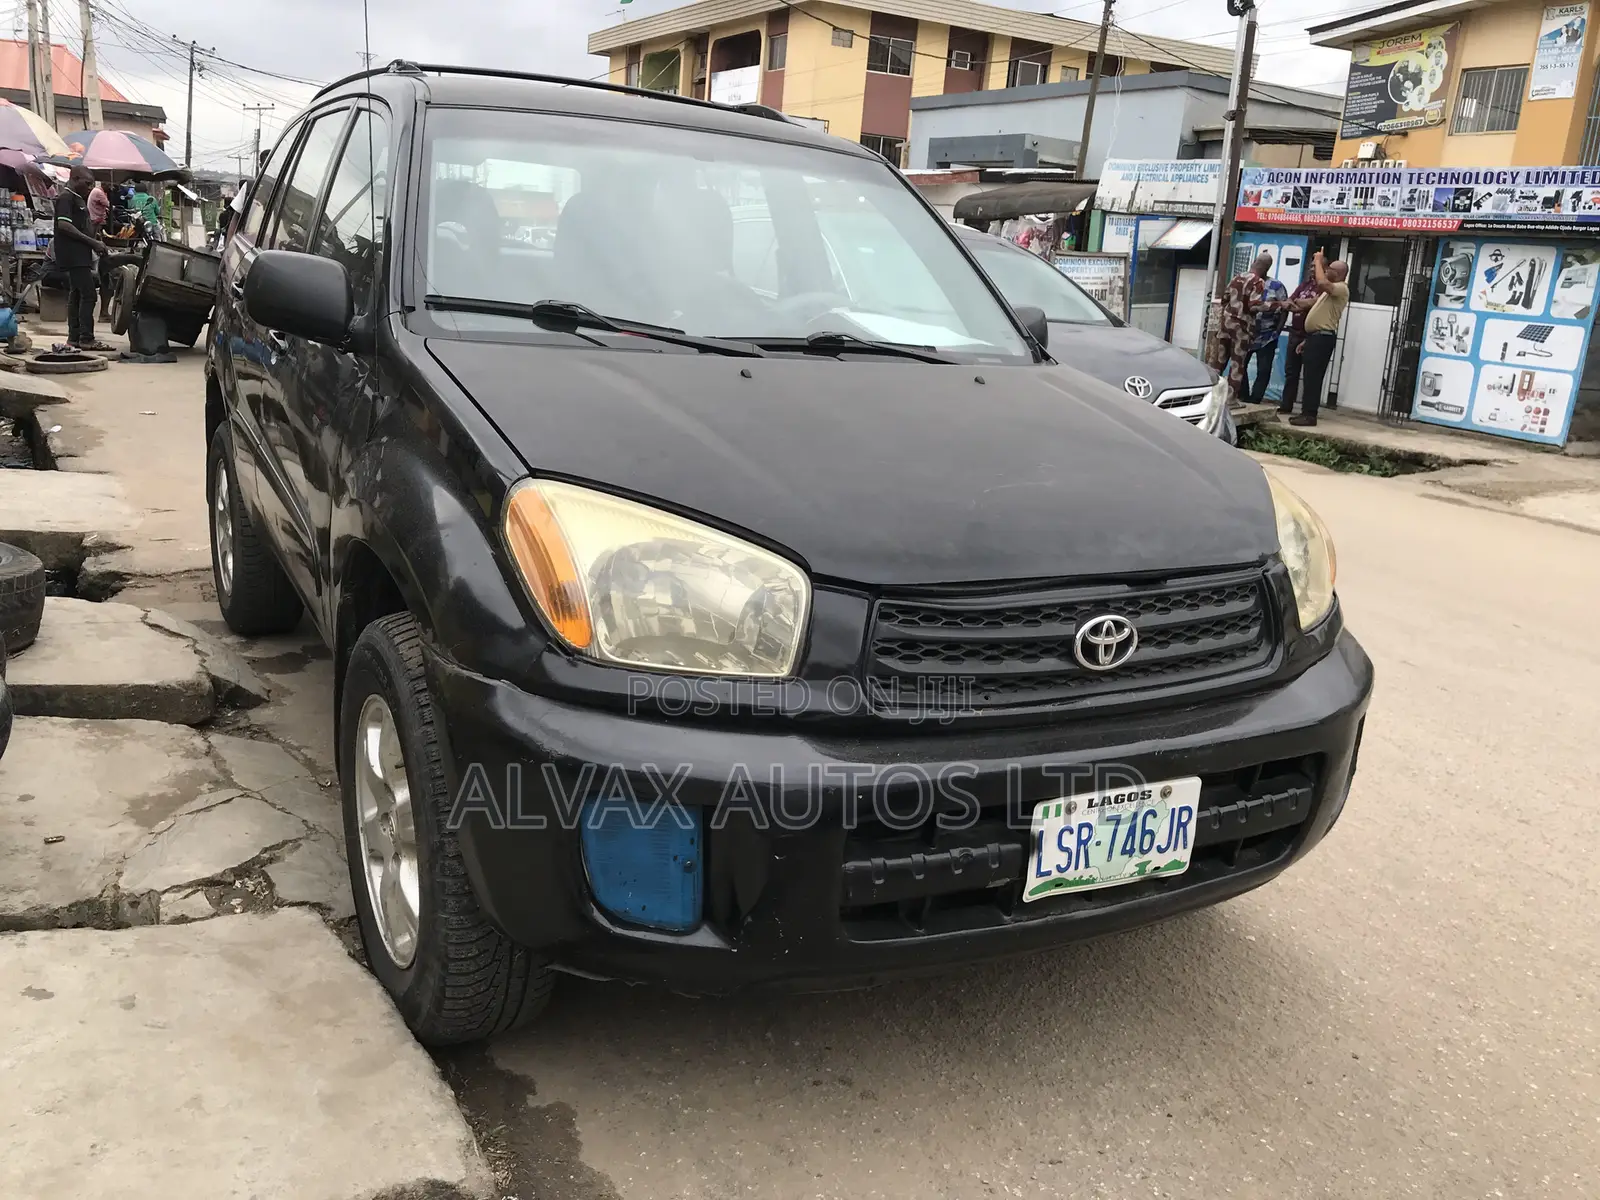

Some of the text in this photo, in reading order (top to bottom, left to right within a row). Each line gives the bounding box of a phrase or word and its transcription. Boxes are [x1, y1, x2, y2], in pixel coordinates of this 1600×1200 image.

[1558, 5, 1584, 14] KARLS
[1379, 34, 1422, 49] JOREM
[1137, 163, 1169, 172] EXCLUSIVE
[1170, 163, 1202, 172] PROPERTY
[1203, 164, 1222, 173] LIMIT
[1121, 173, 1132, 181] AND
[1134, 173, 1169, 182] ELECTRICAL
[1171, 174, 1209, 183] APPLIANCES
[1267, 171, 1600, 185] ACON INFORMATION TECHNOLOGY LIMITED
[1402, 219, 1459, 229] 08032156537
[1116, 227, 1128, 236] SALES
[1095, 289, 1107, 301] FLAT
[1086, 789, 1152, 808] LAGOS
